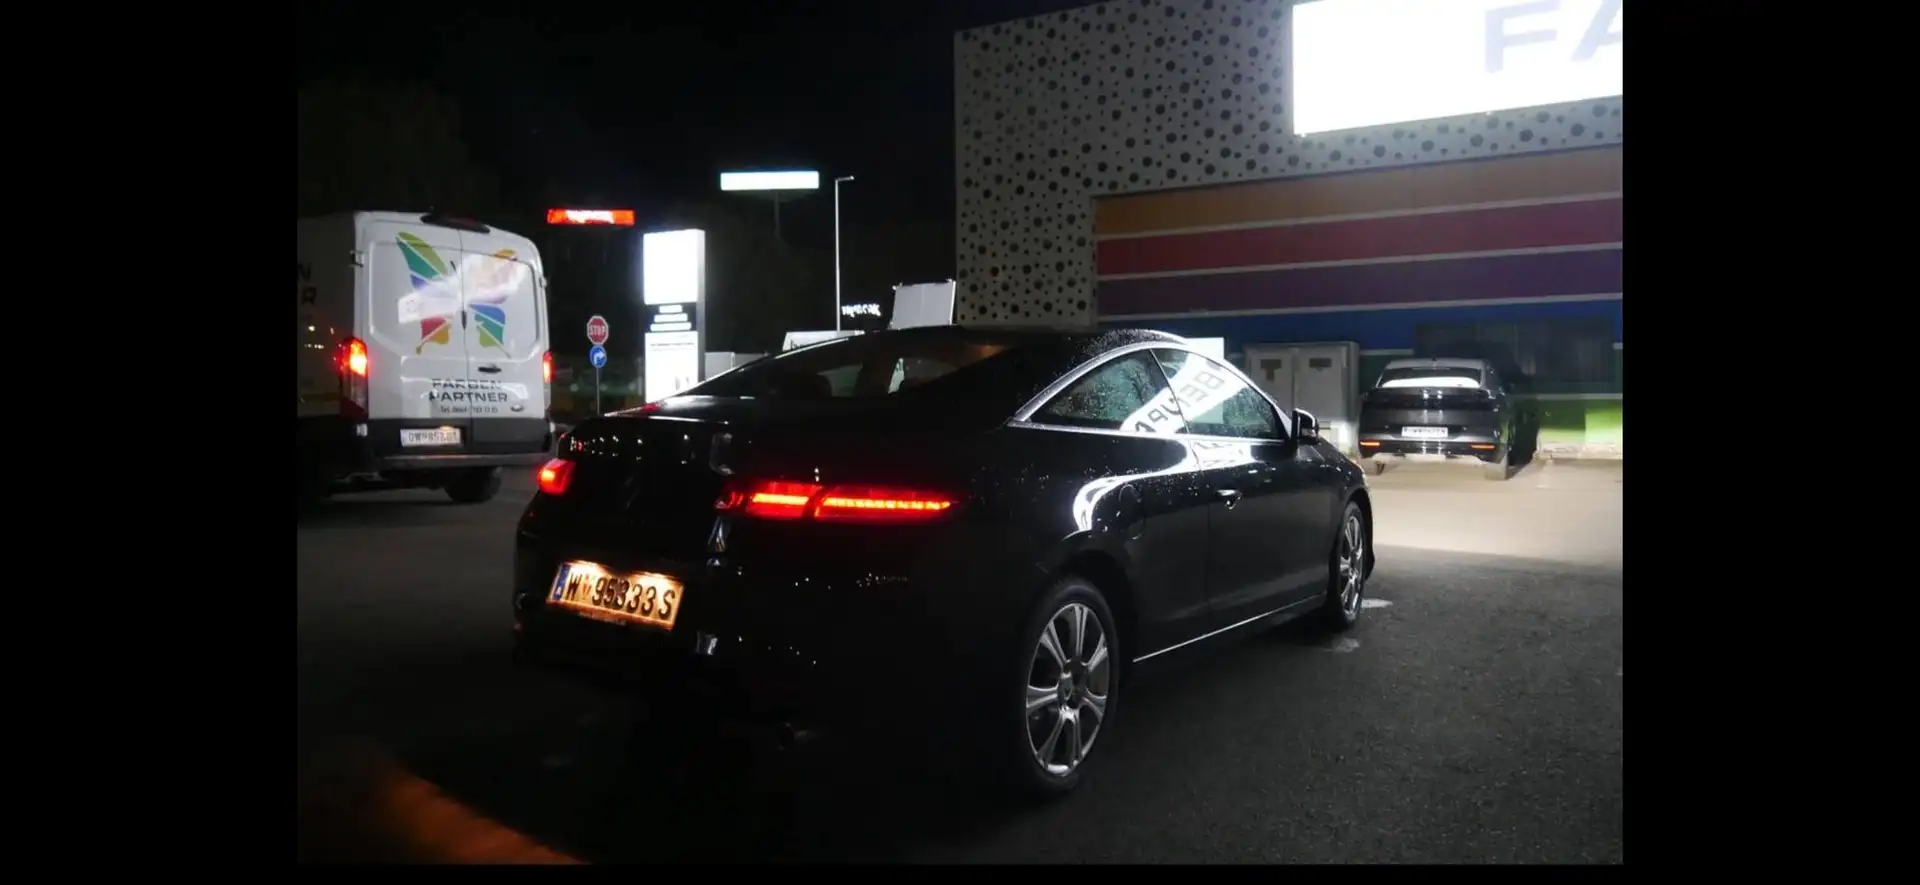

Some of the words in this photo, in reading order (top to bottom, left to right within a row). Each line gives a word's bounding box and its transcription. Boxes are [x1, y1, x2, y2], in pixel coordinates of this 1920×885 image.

[589, 325, 606, 337] STOP
[428, 391, 508, 404] PARTNER
[566, 572, 582, 601] W
[658, 589, 676, 620] S
